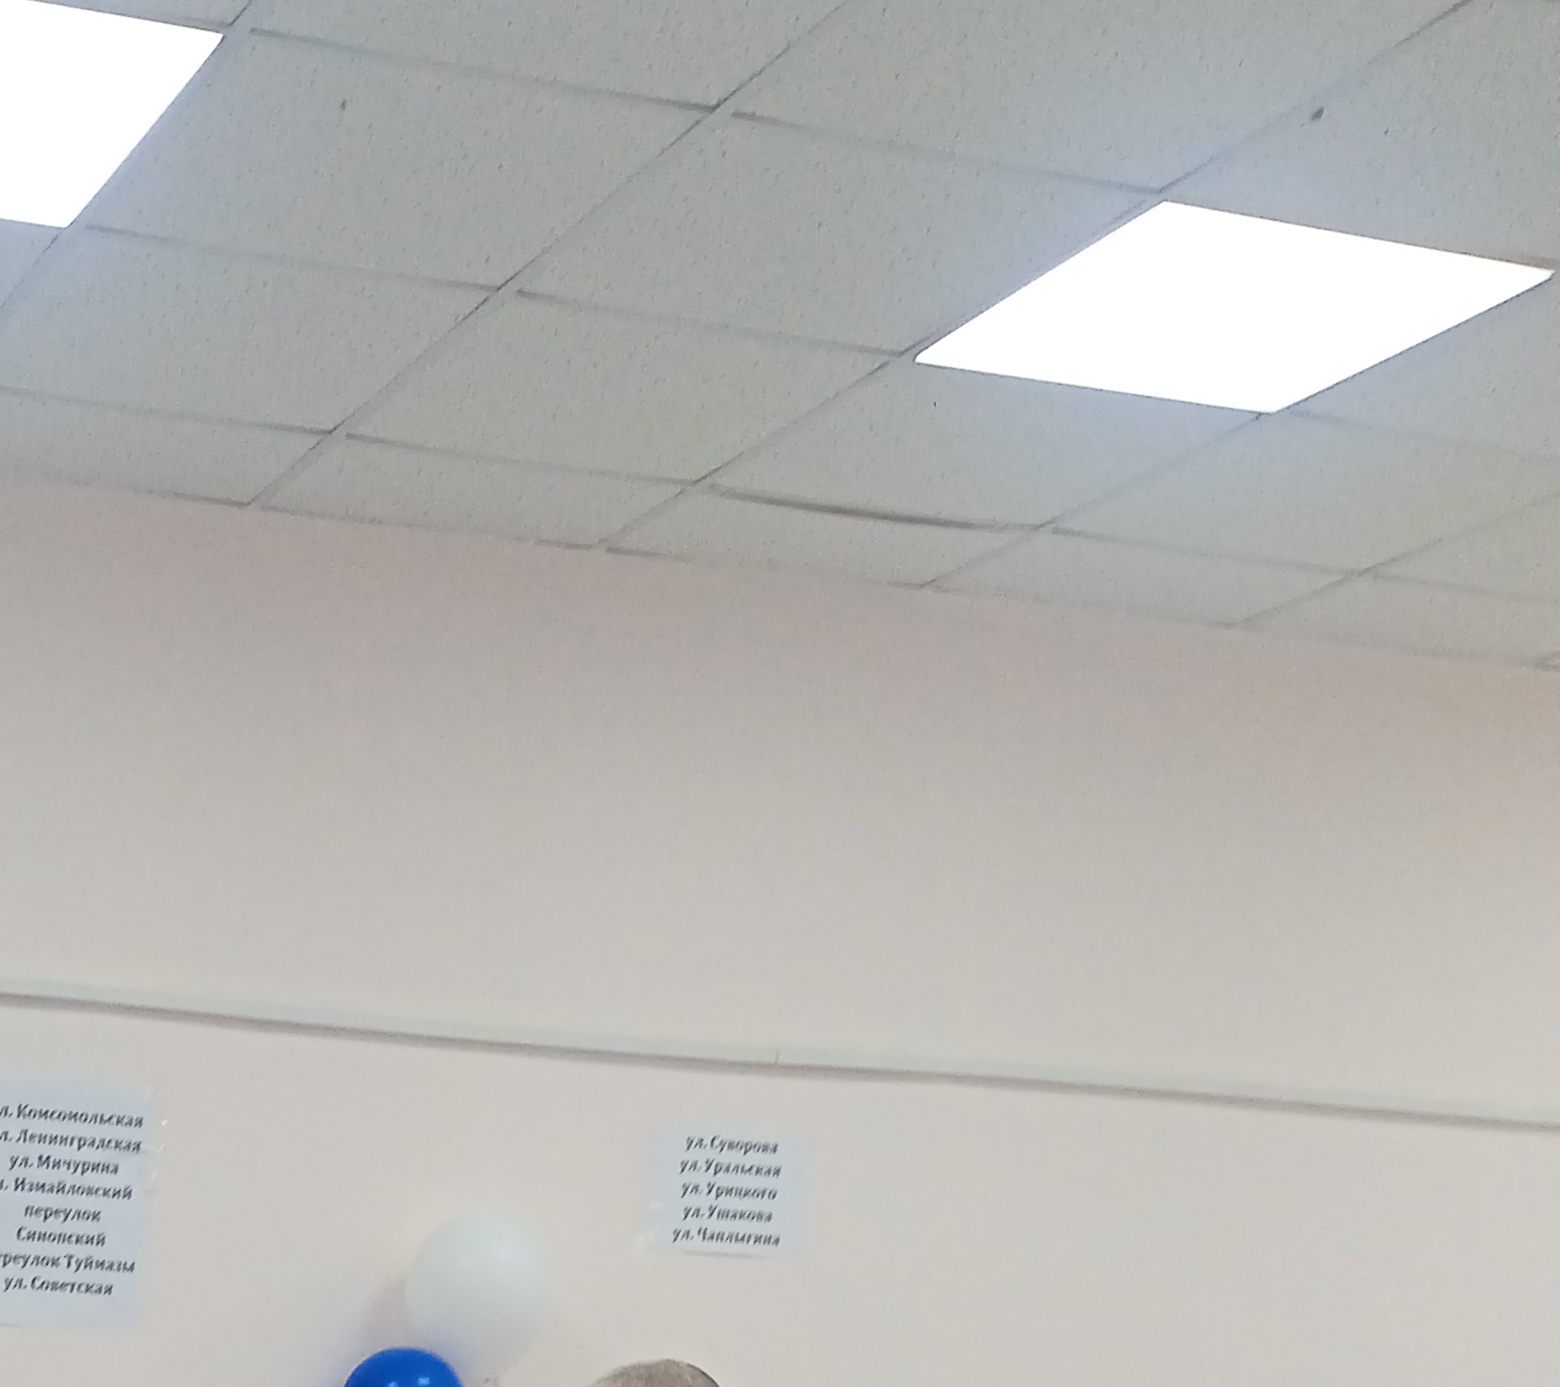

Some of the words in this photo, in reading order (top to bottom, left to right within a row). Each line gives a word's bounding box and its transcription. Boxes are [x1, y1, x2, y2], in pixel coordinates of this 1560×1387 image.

[16, 1103, 144, 1128] Комсомольская
[14, 1128, 141, 1152] Ленинградская
[685, 1135, 706, 1151] ул.
[709, 1135, 779, 1155] Суворова
[8, 1153, 33, 1170] ул.
[36, 1154, 119, 1175] Мичурина
[678, 1158, 701, 1174] ул.
[703, 1158, 781, 1178] Уральская
[13, 1177, 133, 1200] Измайловский
[680, 1181, 701, 1198] ул.
[705, 1181, 777, 1200] Урицкого
[23, 1204, 101, 1224] переулок
[681, 1204, 703, 1221] ул.
[707, 1203, 773, 1222] Ушакова
[15, 1226, 106, 1246] Синопский
[671, 1227, 693, 1243] ул.
[63, 1253, 135, 1273] Туймазы
[2, 1276, 27, 1293] ул.
[30, 1276, 113, 1295] Советская
